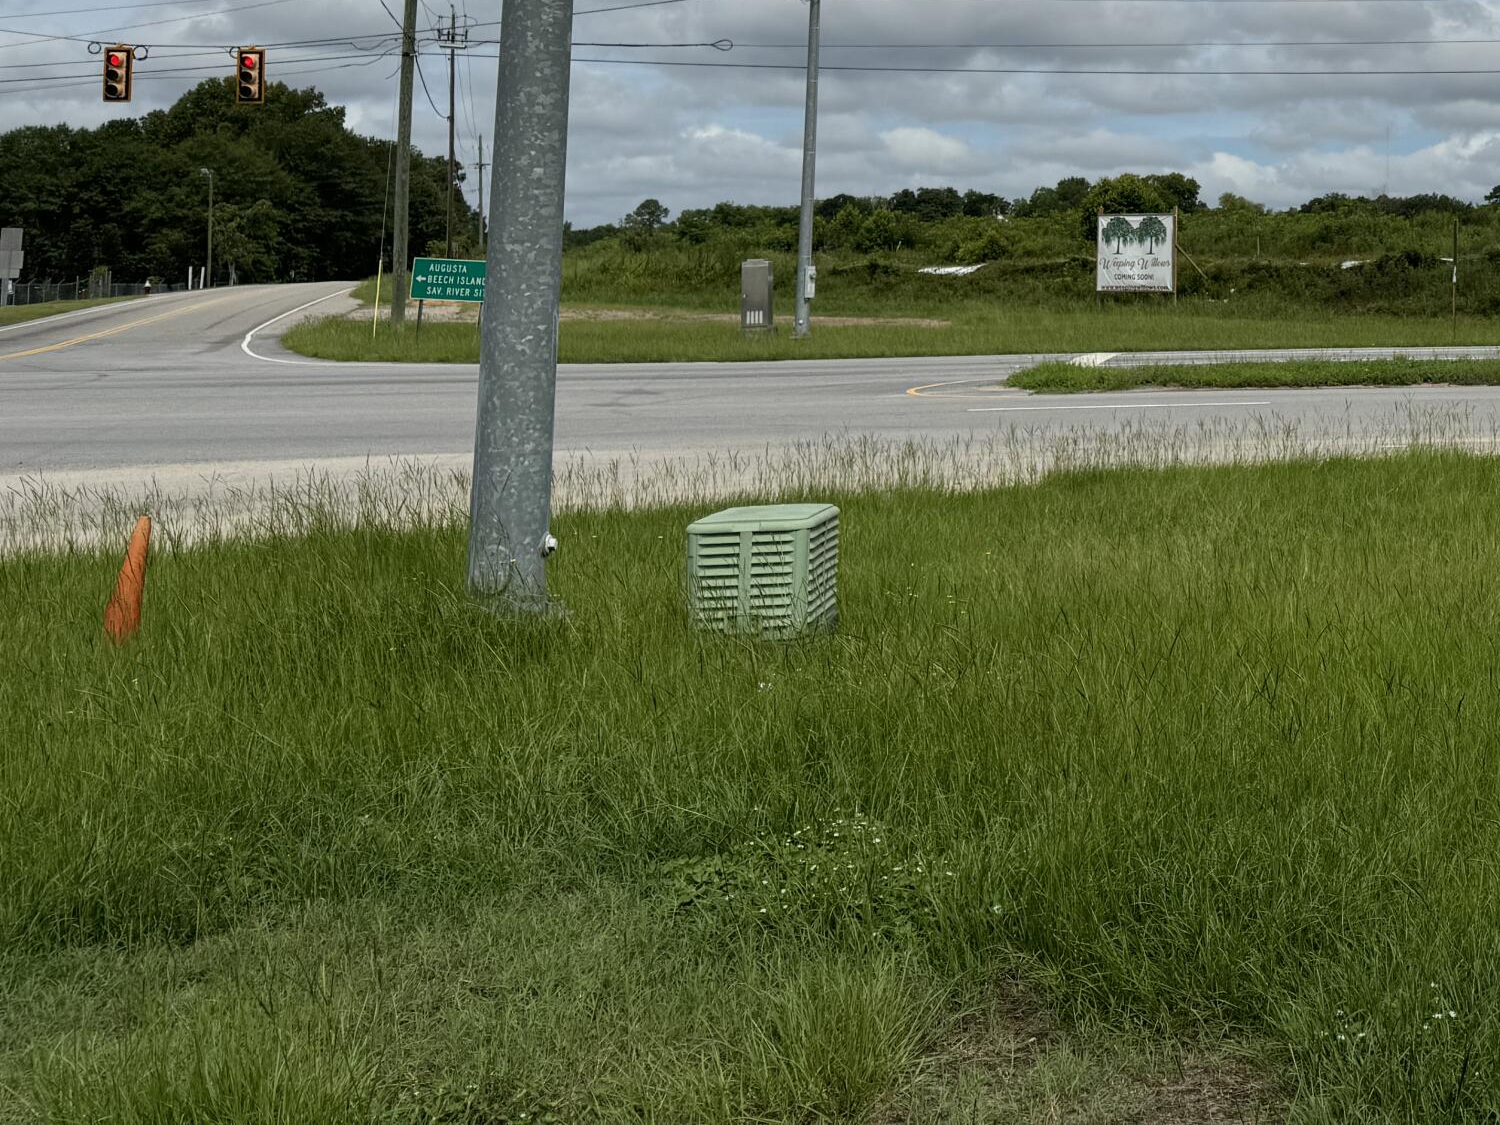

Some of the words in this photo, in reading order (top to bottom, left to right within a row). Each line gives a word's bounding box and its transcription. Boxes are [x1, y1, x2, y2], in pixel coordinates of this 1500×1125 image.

[429, 264, 467, 273] AUGUSTA
[1099, 258, 1135, 271] Weeping
[1137, 257, 1171, 270] Willows
[427, 275, 454, 284] BEECH
[446, 288, 470, 297] RIVER
